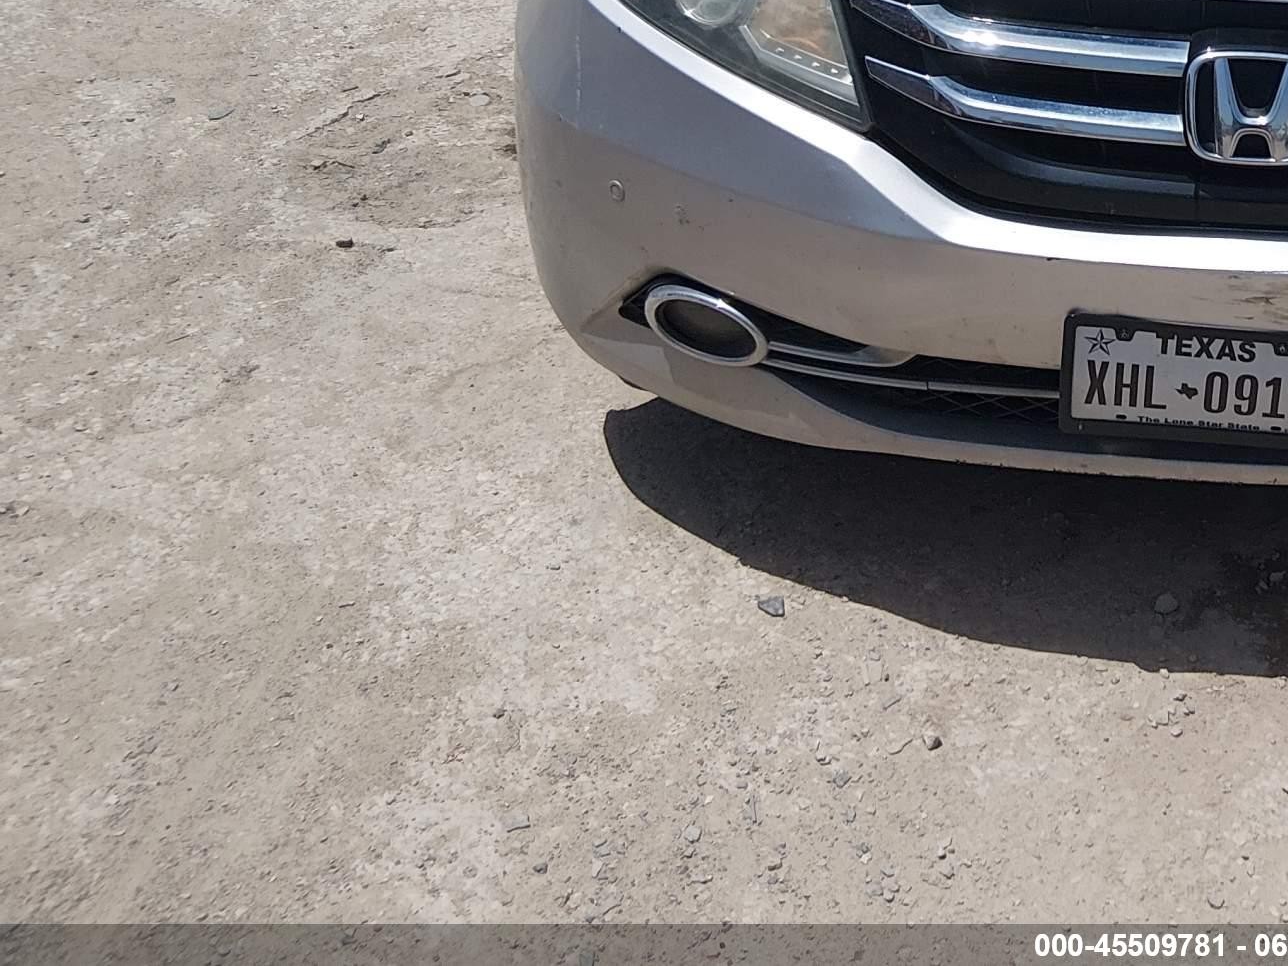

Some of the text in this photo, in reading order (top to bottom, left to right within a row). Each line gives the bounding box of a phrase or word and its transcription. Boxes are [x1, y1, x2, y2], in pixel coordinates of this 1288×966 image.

[1157, 334, 1256, 362] TEXAS
[1084, 360, 1167, 409] XHL
[1137, 416, 1260, 431] The Lone Star State
